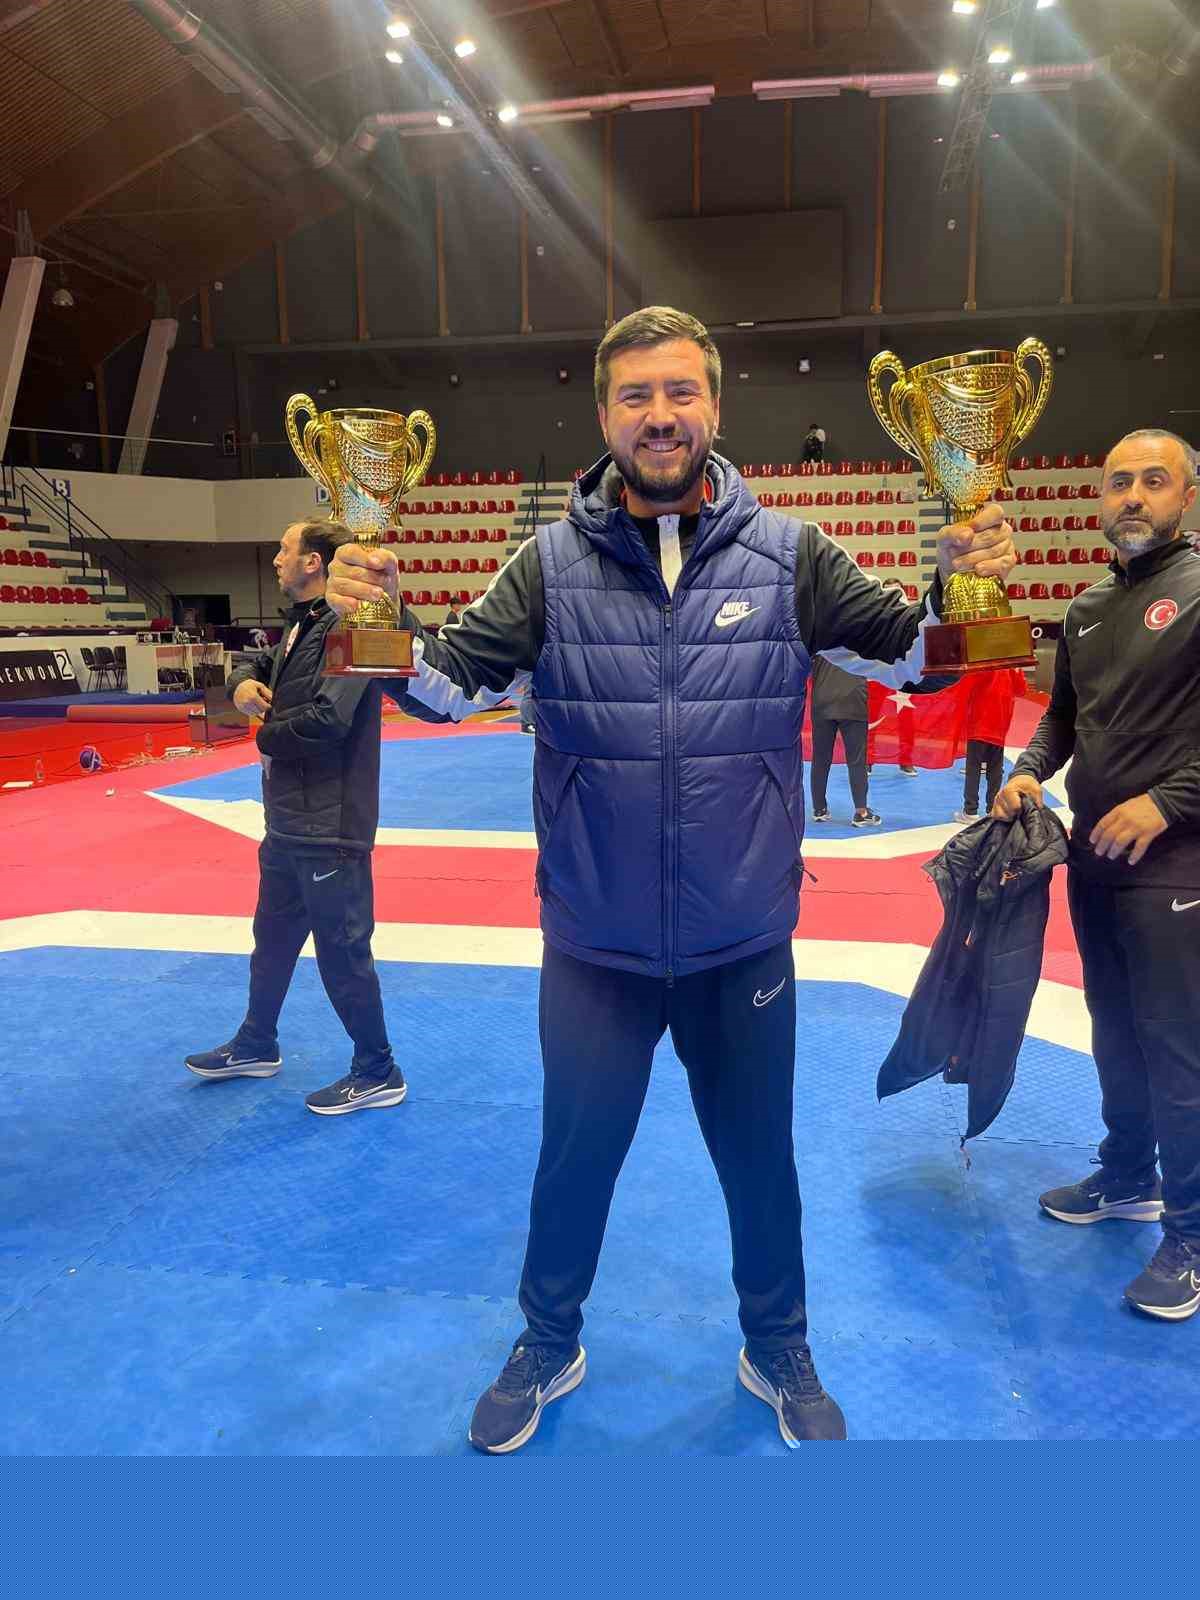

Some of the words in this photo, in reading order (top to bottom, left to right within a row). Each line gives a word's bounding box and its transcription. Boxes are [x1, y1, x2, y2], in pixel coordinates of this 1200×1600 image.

[56, 480, 68, 497] B
[720, 601, 750, 617] NIKE
[56, 653, 74, 678] 2
